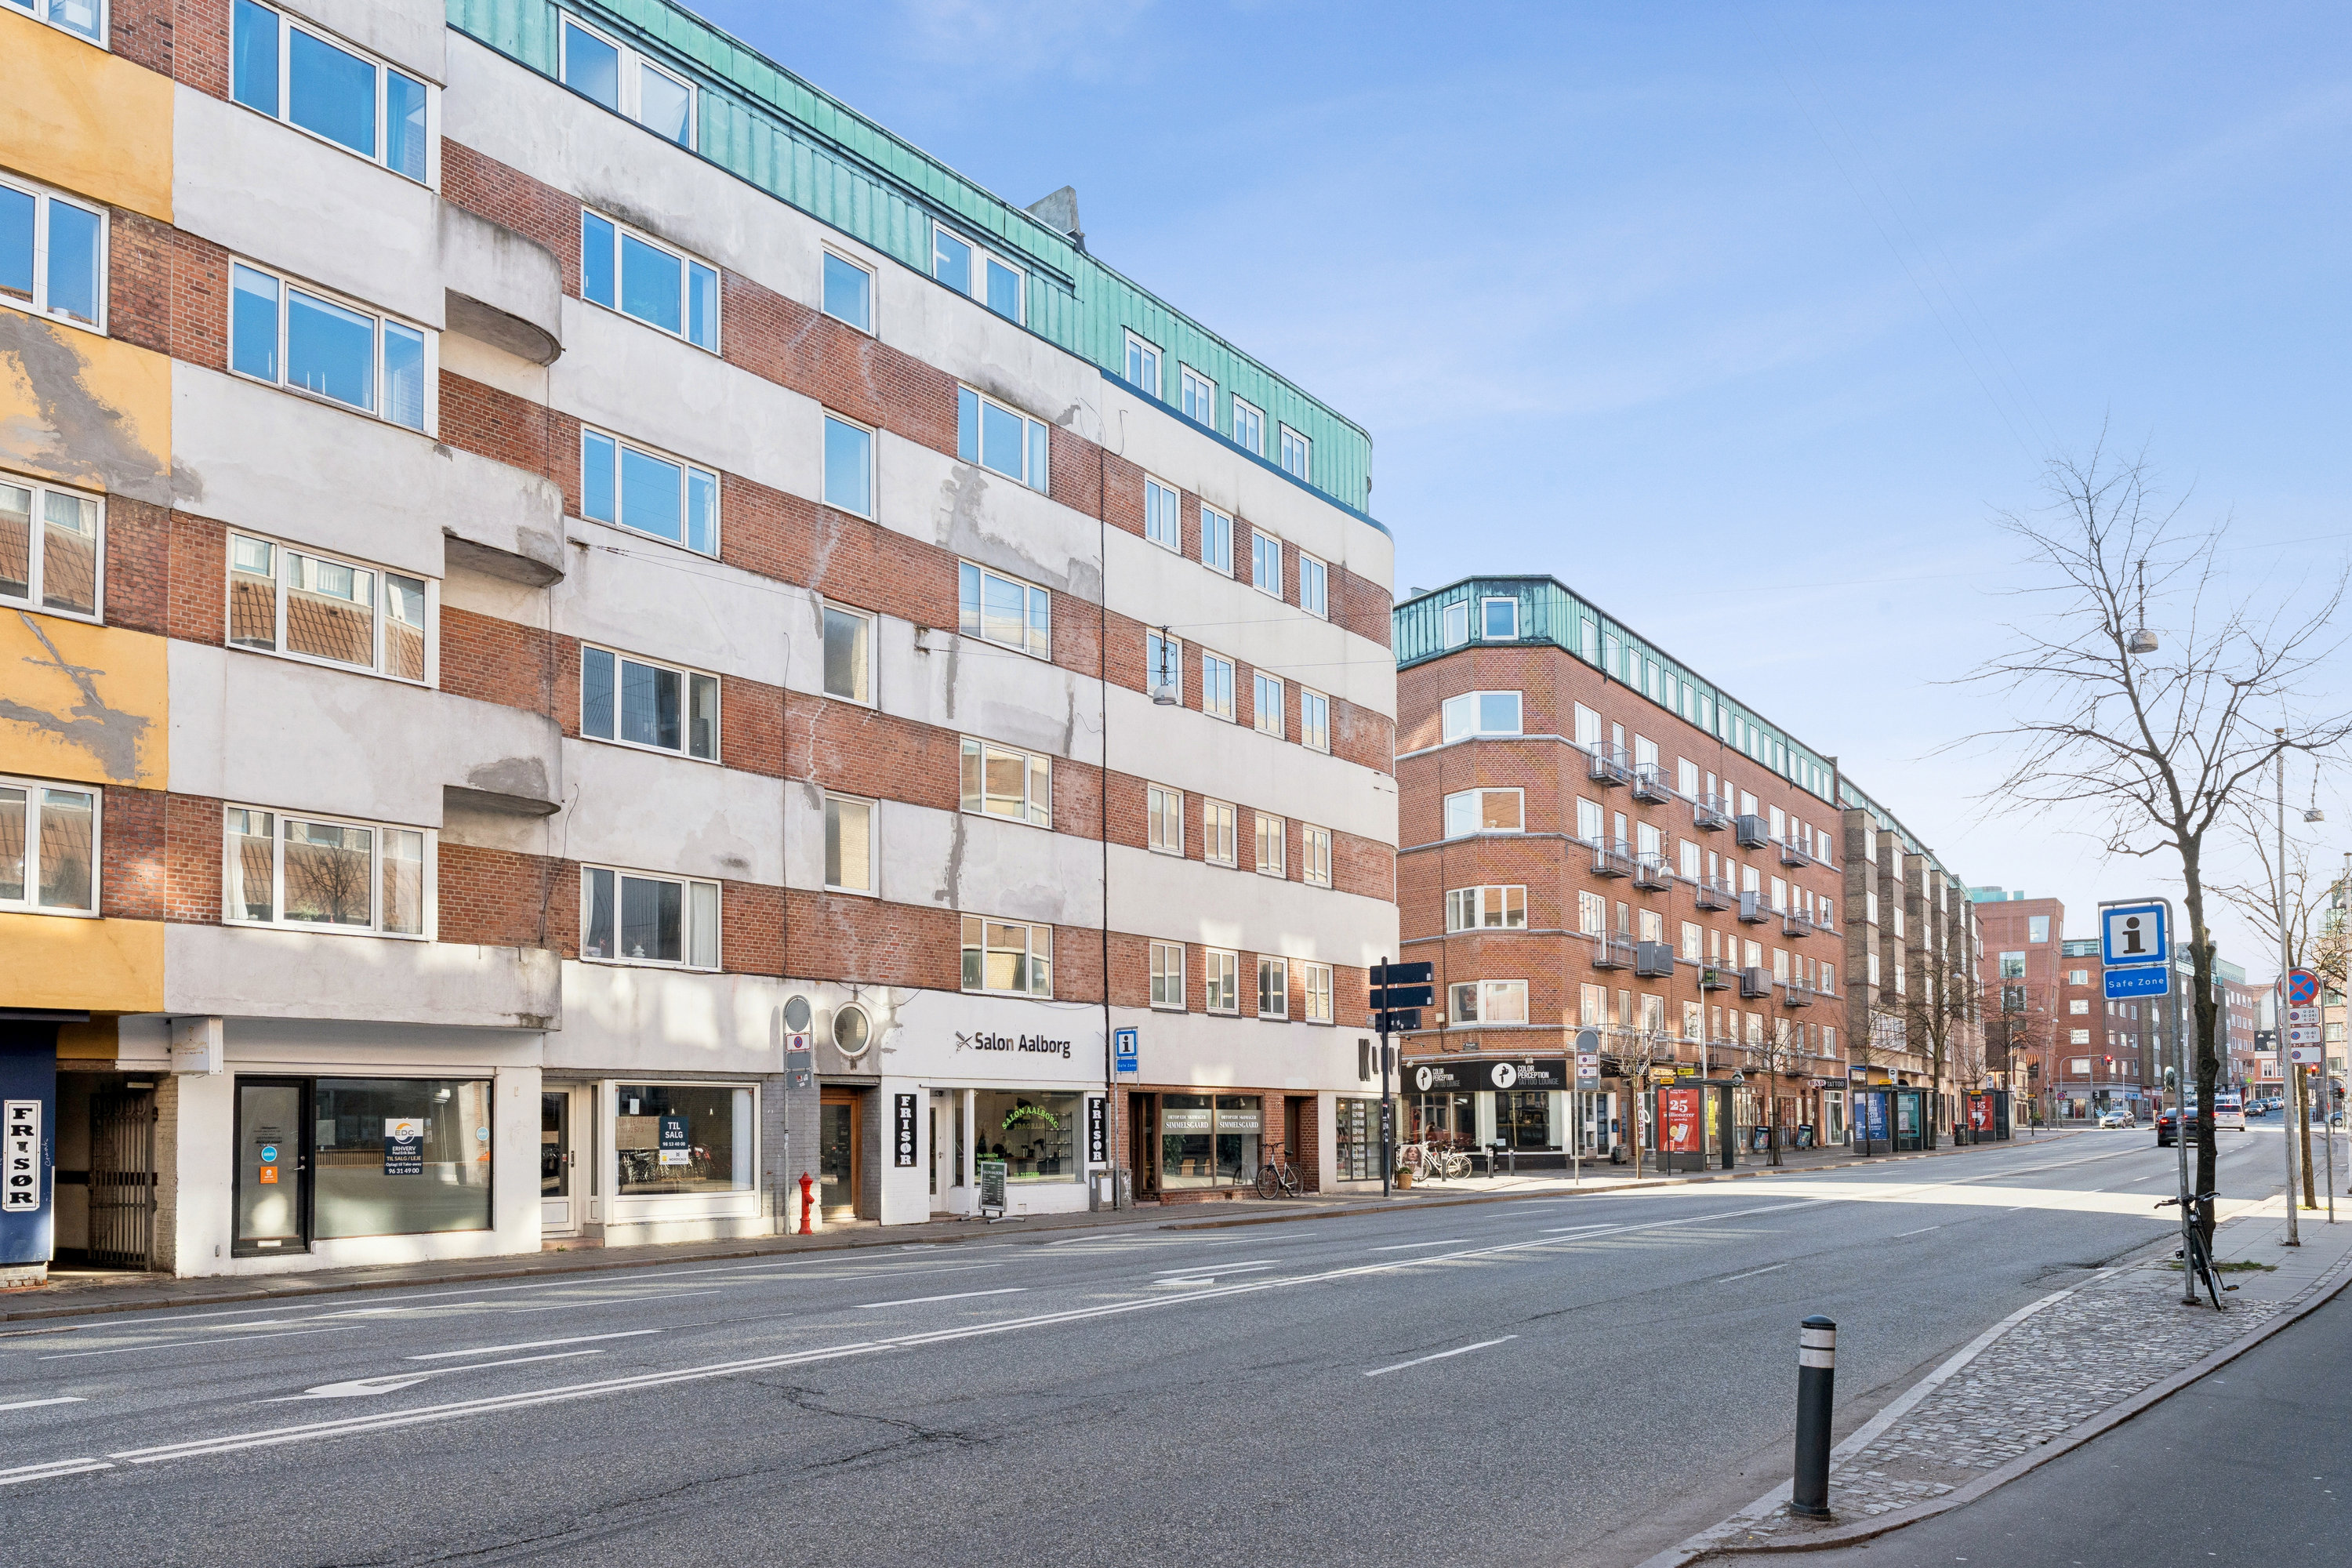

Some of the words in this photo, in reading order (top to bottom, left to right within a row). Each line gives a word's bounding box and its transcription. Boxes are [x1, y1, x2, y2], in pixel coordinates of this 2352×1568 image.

[975, 1032, 1014, 1051] Salon
[1018, 1034, 1071, 1058] Aalborg
[1002, 1107, 1024, 1129] SALON
[1027, 1107, 1059, 1129] AALBORG
[1670, 1099, 1688, 1113] 25
[900, 1096, 911, 1165] FRISØR
[1093, 1100, 1102, 1160] FRISØR
[9, 1108, 34, 1203] FRISØR
